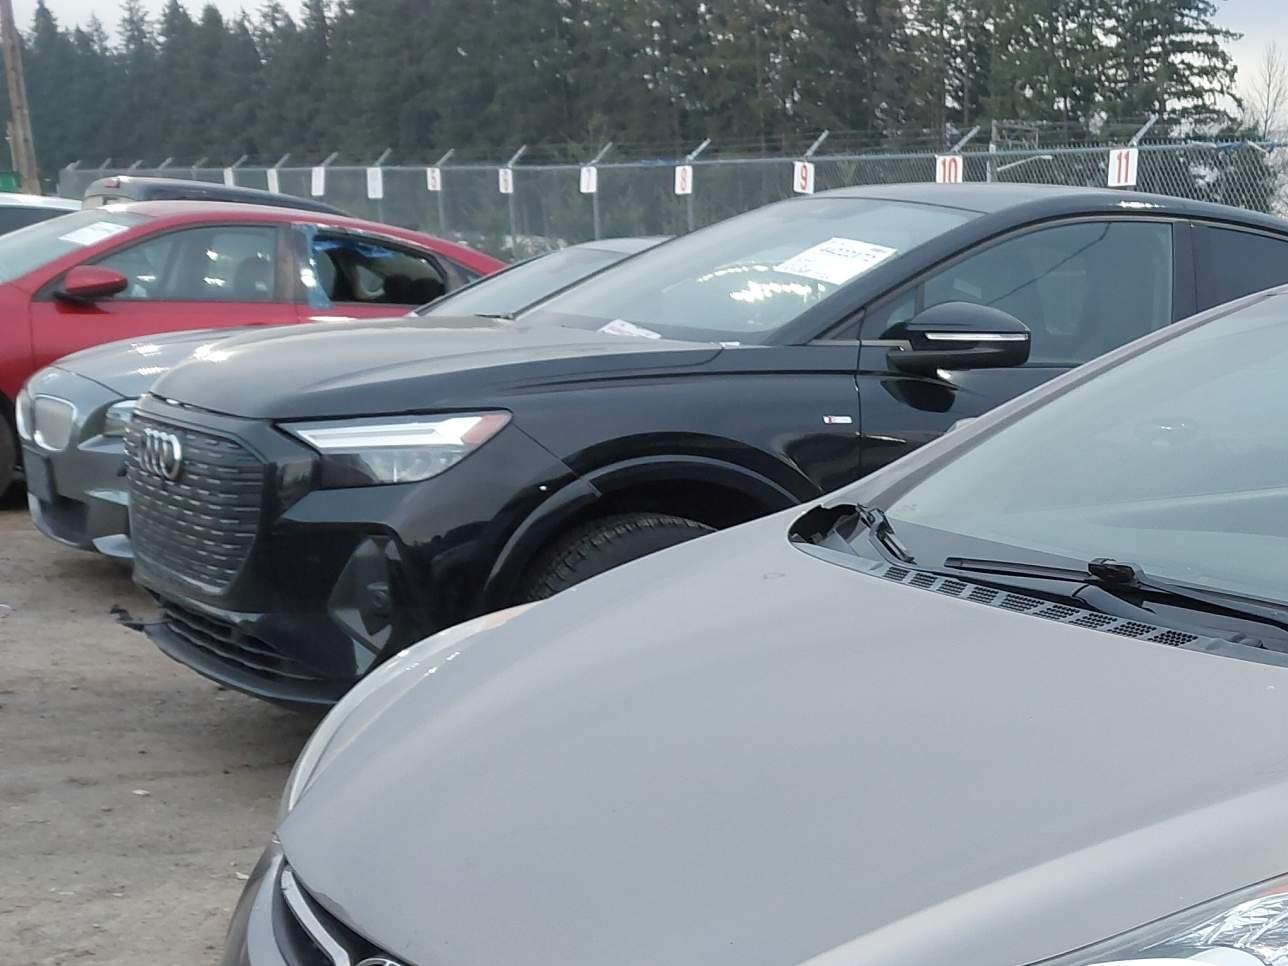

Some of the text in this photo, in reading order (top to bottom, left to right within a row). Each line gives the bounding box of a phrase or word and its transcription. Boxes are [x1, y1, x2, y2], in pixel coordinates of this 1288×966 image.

[799, 164, 808, 190] 9
[941, 157, 958, 184] 10
[1116, 150, 1130, 184] 11
